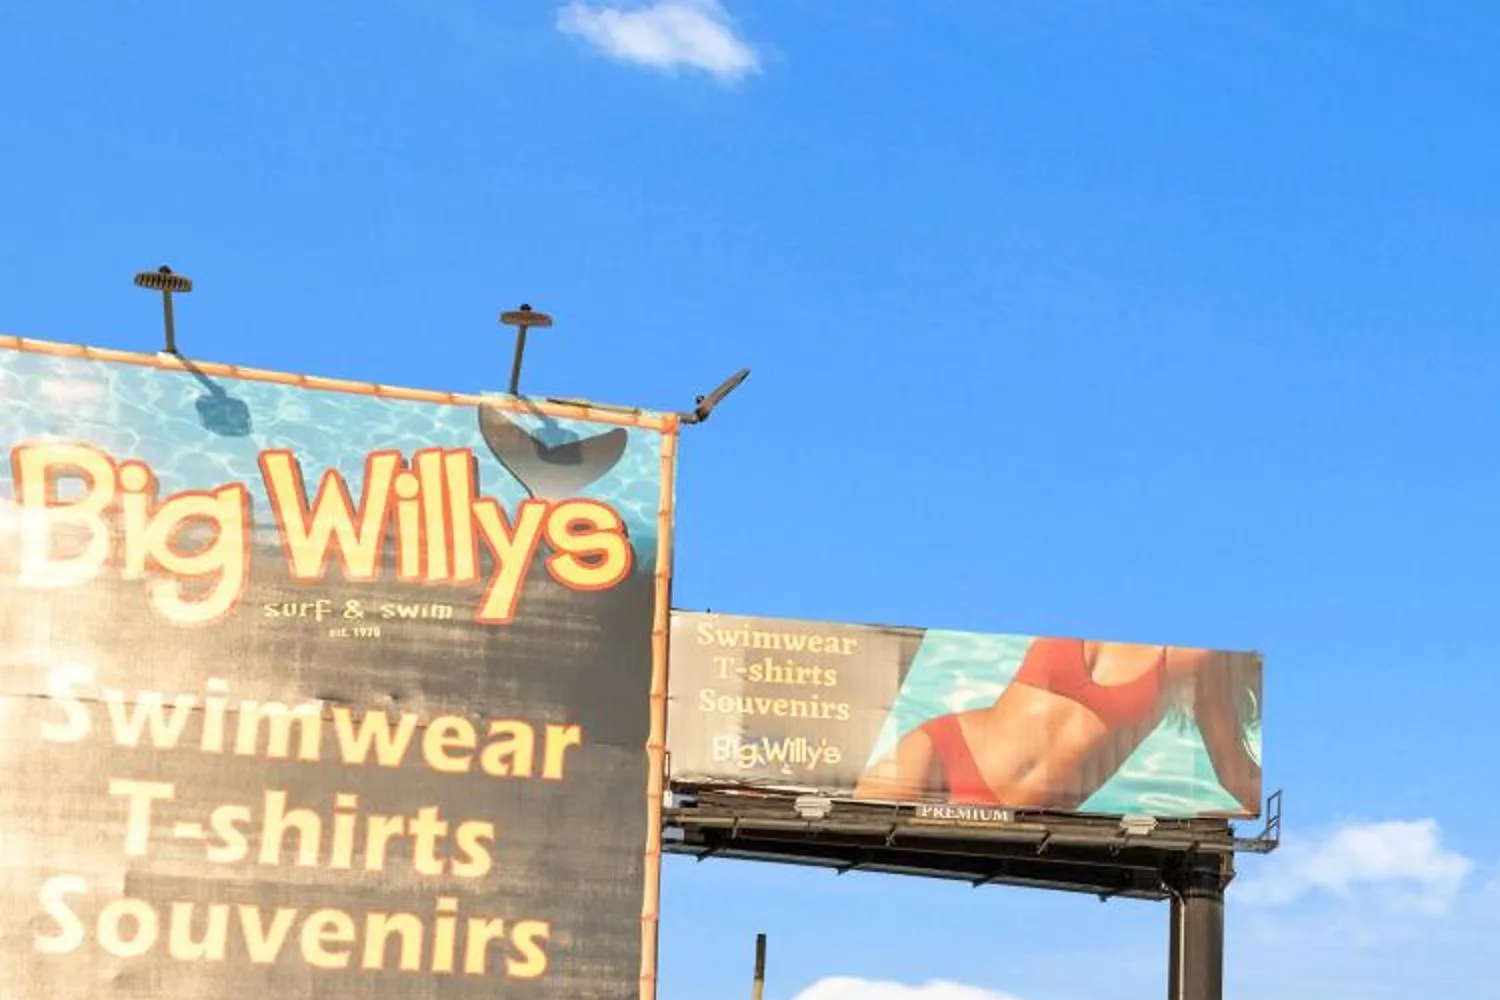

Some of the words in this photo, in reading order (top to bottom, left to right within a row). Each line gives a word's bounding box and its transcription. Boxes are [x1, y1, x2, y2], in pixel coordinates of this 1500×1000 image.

[11, 440, 249, 628] Big
[258, 447, 630, 624] Willys
[263, 599, 332, 622] surf
[342, 599, 365, 619] &
[378, 602, 453, 620] swim
[697, 620, 858, 655] Swimwear
[714, 655, 838, 687] T-shirts
[700, 688, 850, 721] Souvenirs
[40, 665, 581, 780] Swimwear
[108, 778, 496, 879] T-shirts
[921, 804, 1009, 821] PREMIUM
[33, 875, 551, 979] Souvenirs
